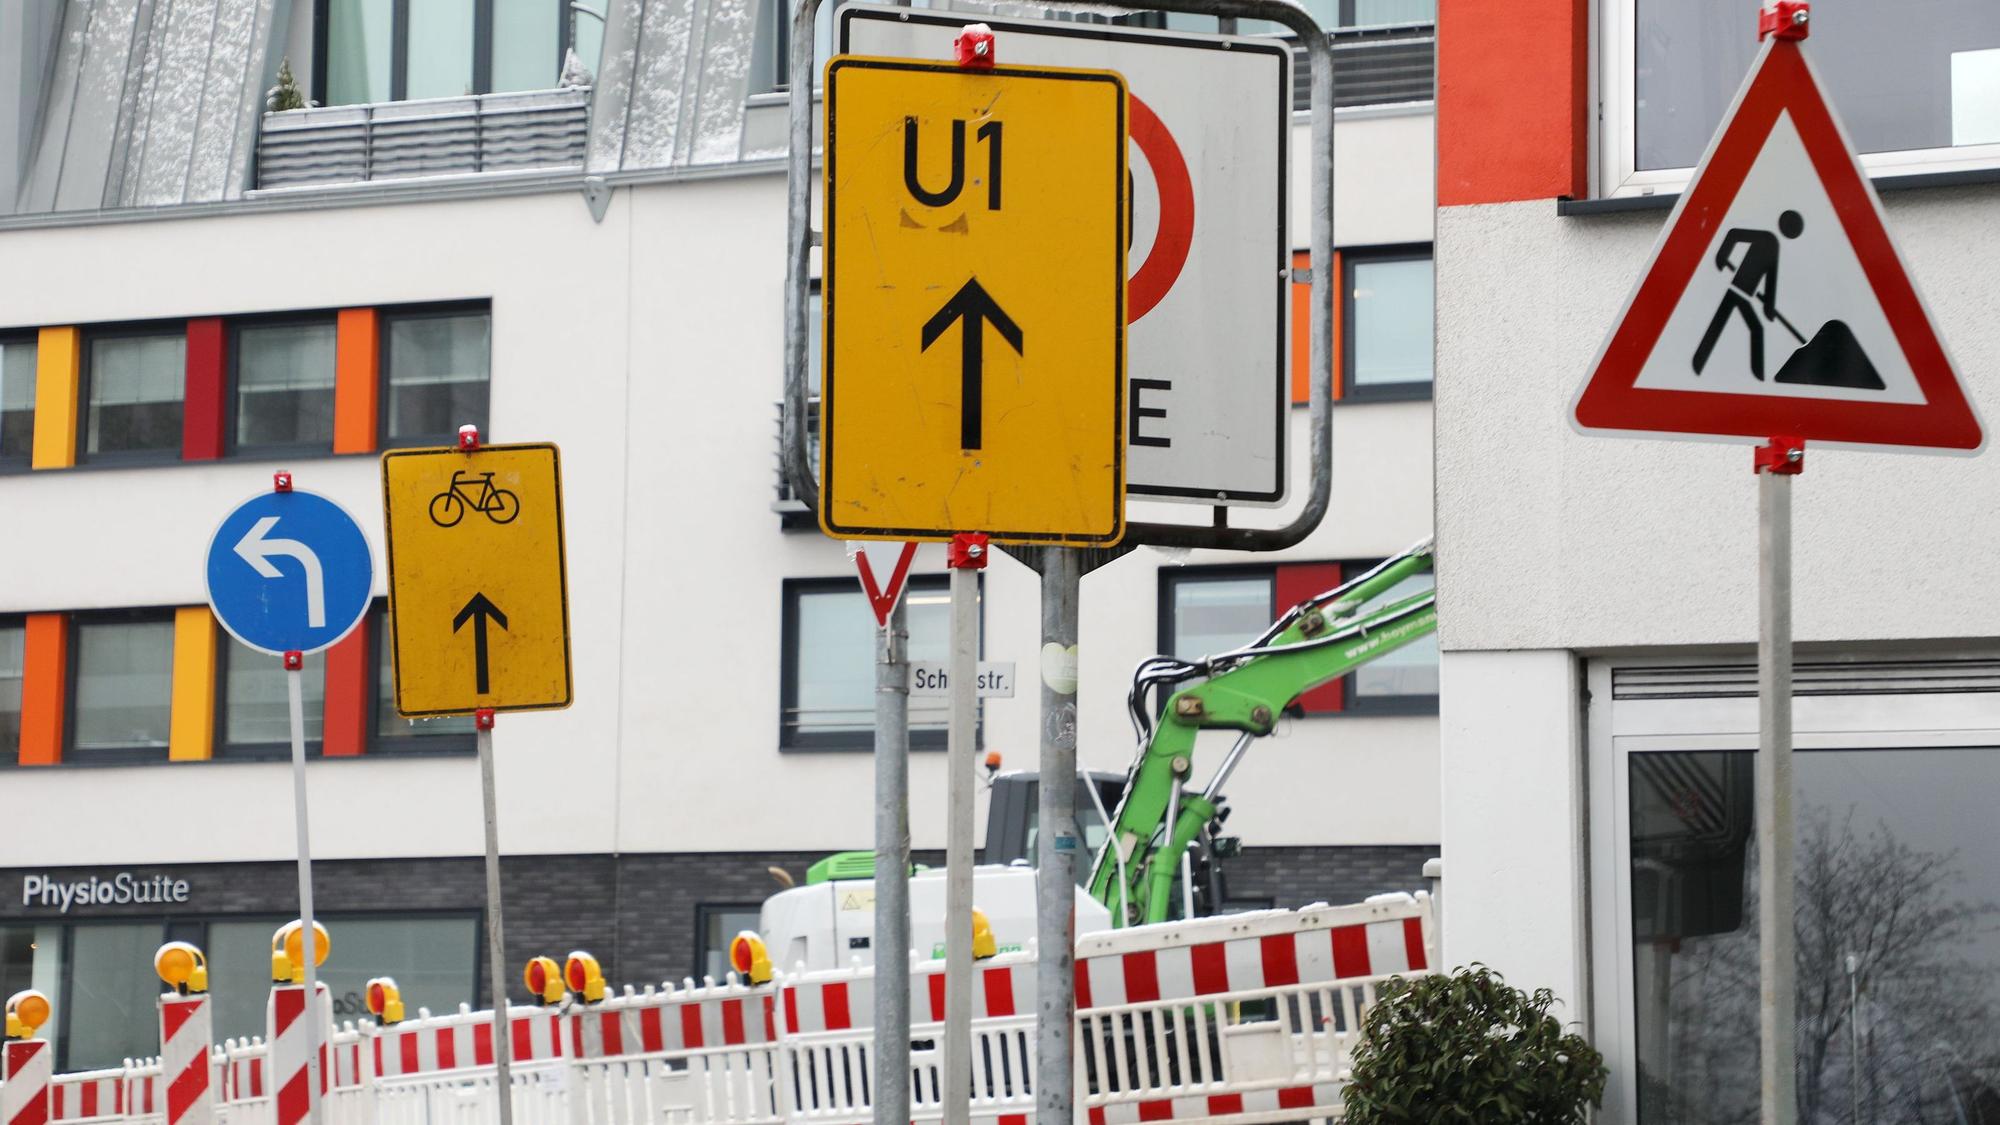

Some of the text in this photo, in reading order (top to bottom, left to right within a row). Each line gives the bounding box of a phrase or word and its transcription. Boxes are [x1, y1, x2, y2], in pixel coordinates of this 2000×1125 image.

[904, 115, 1003, 211] U1
[915, 668, 1009, 690] Schstr.
[22, 872, 190, 914] PhysioSuite
